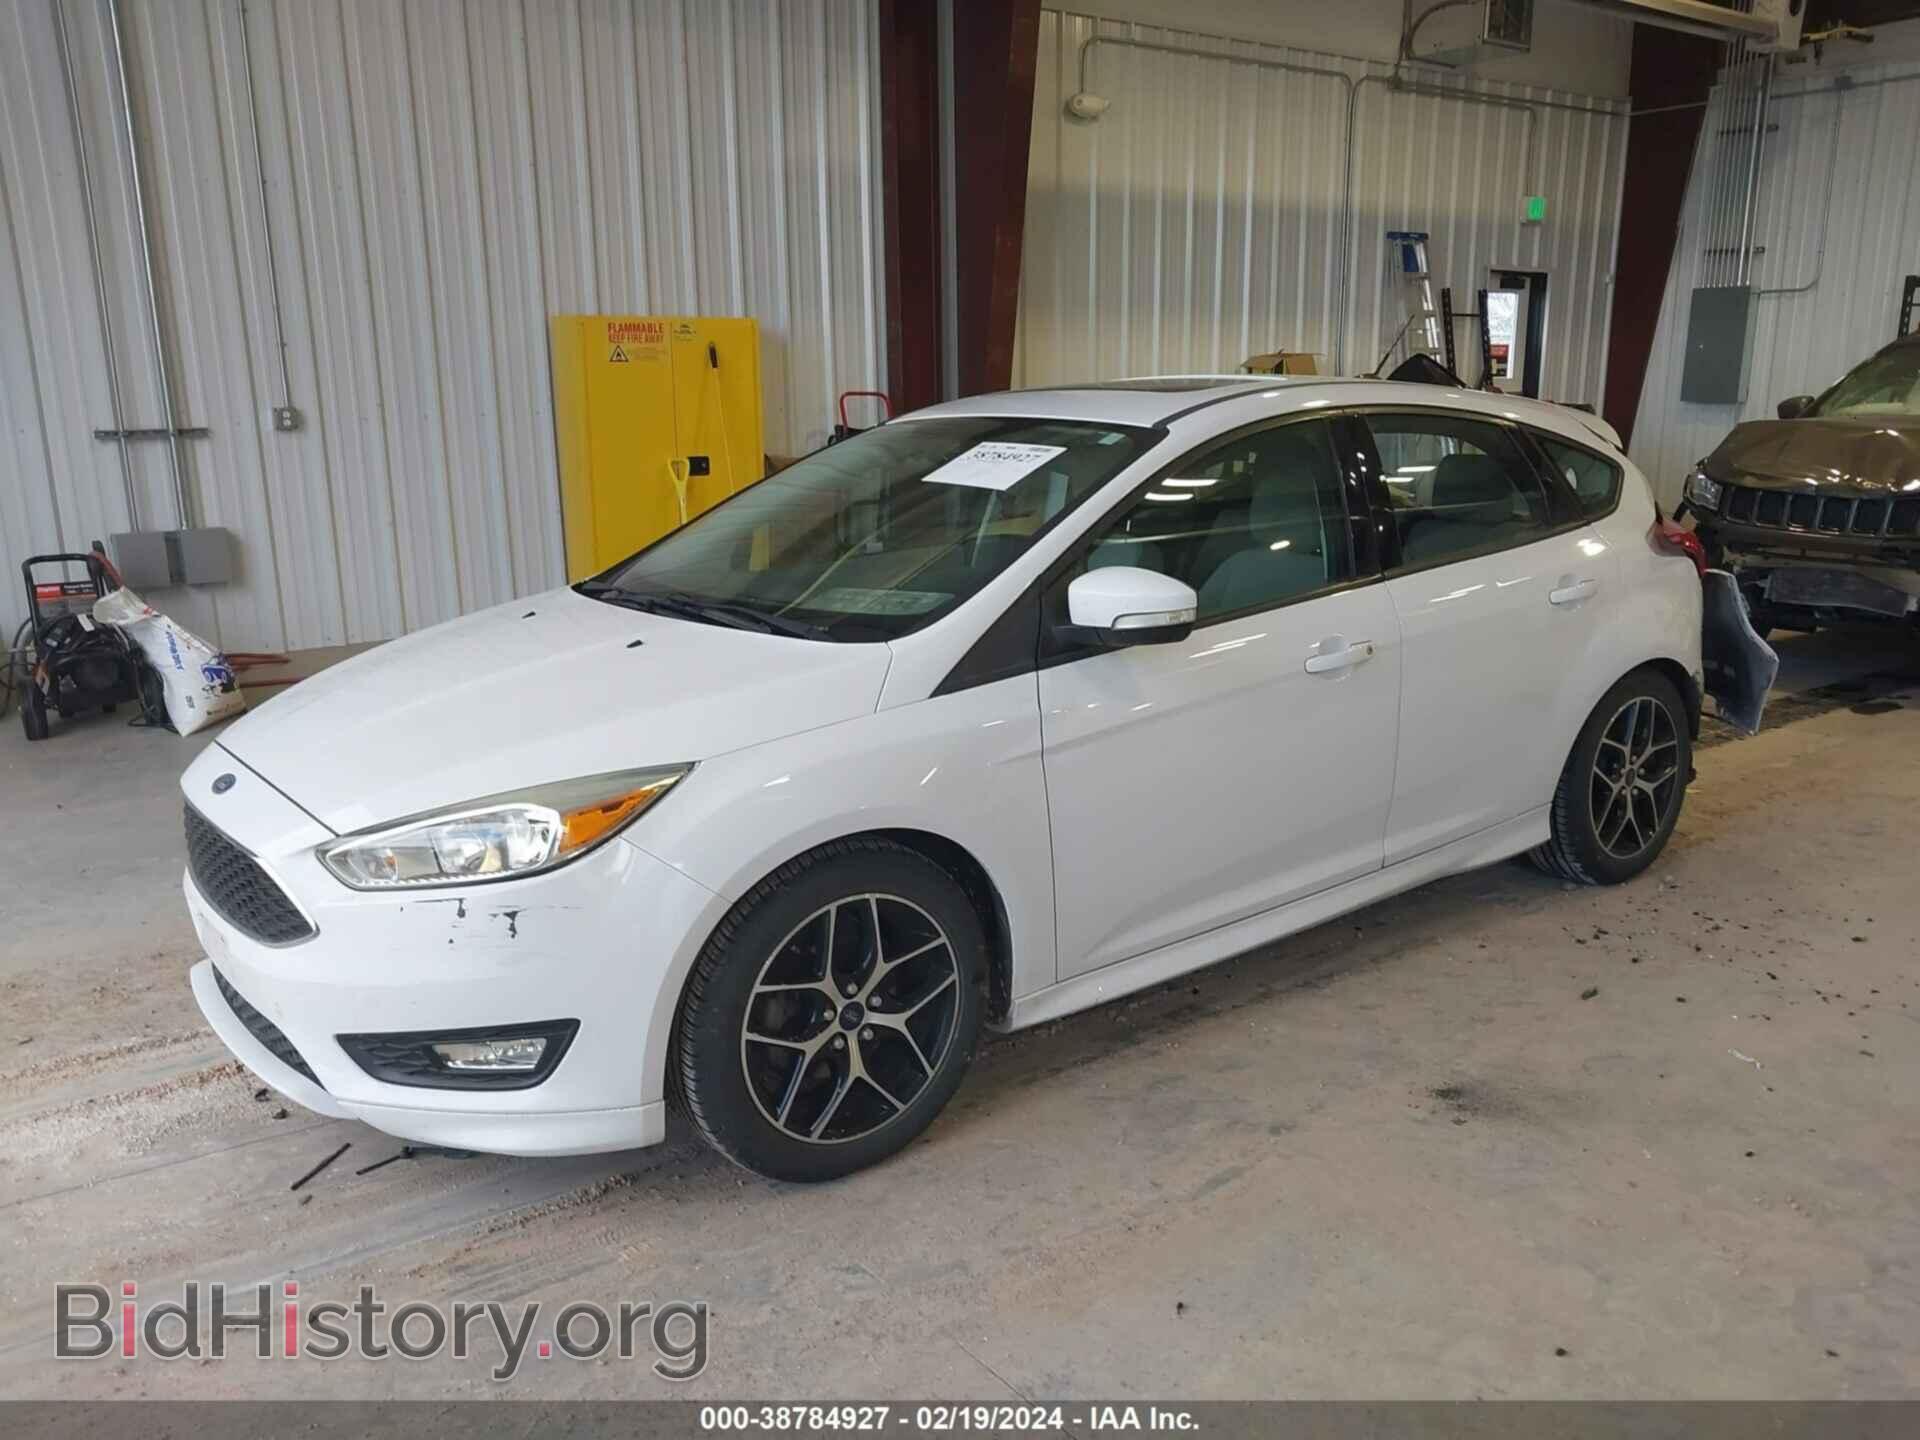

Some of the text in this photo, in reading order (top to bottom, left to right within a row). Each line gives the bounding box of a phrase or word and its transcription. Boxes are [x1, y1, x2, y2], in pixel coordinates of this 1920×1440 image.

[607, 322, 664, 334] FLAMMABLE
[608, 334, 664, 344] KEEP FIRE AWAY
